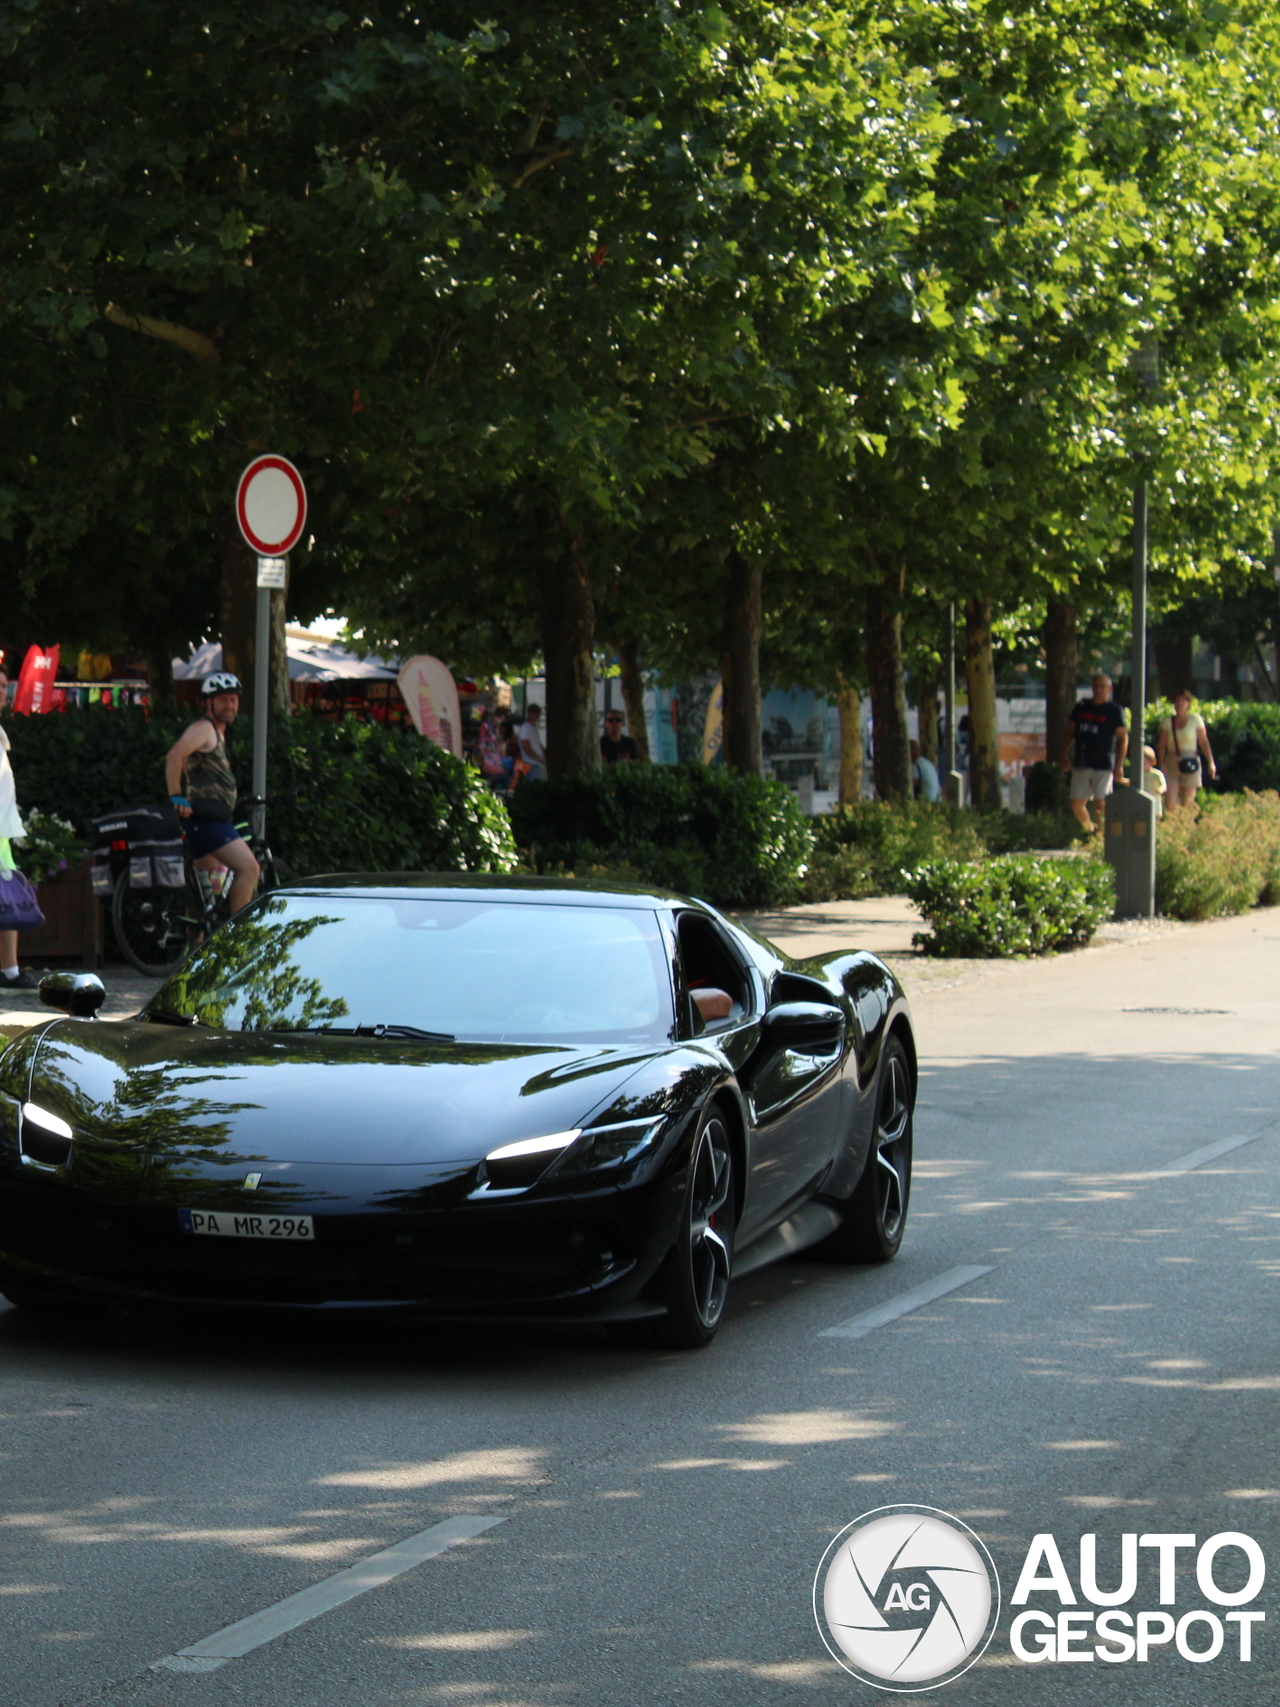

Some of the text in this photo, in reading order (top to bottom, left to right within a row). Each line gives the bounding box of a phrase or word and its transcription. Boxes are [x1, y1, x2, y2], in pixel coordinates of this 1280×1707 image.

[191, 1213, 310, 1237] PA MR 296
